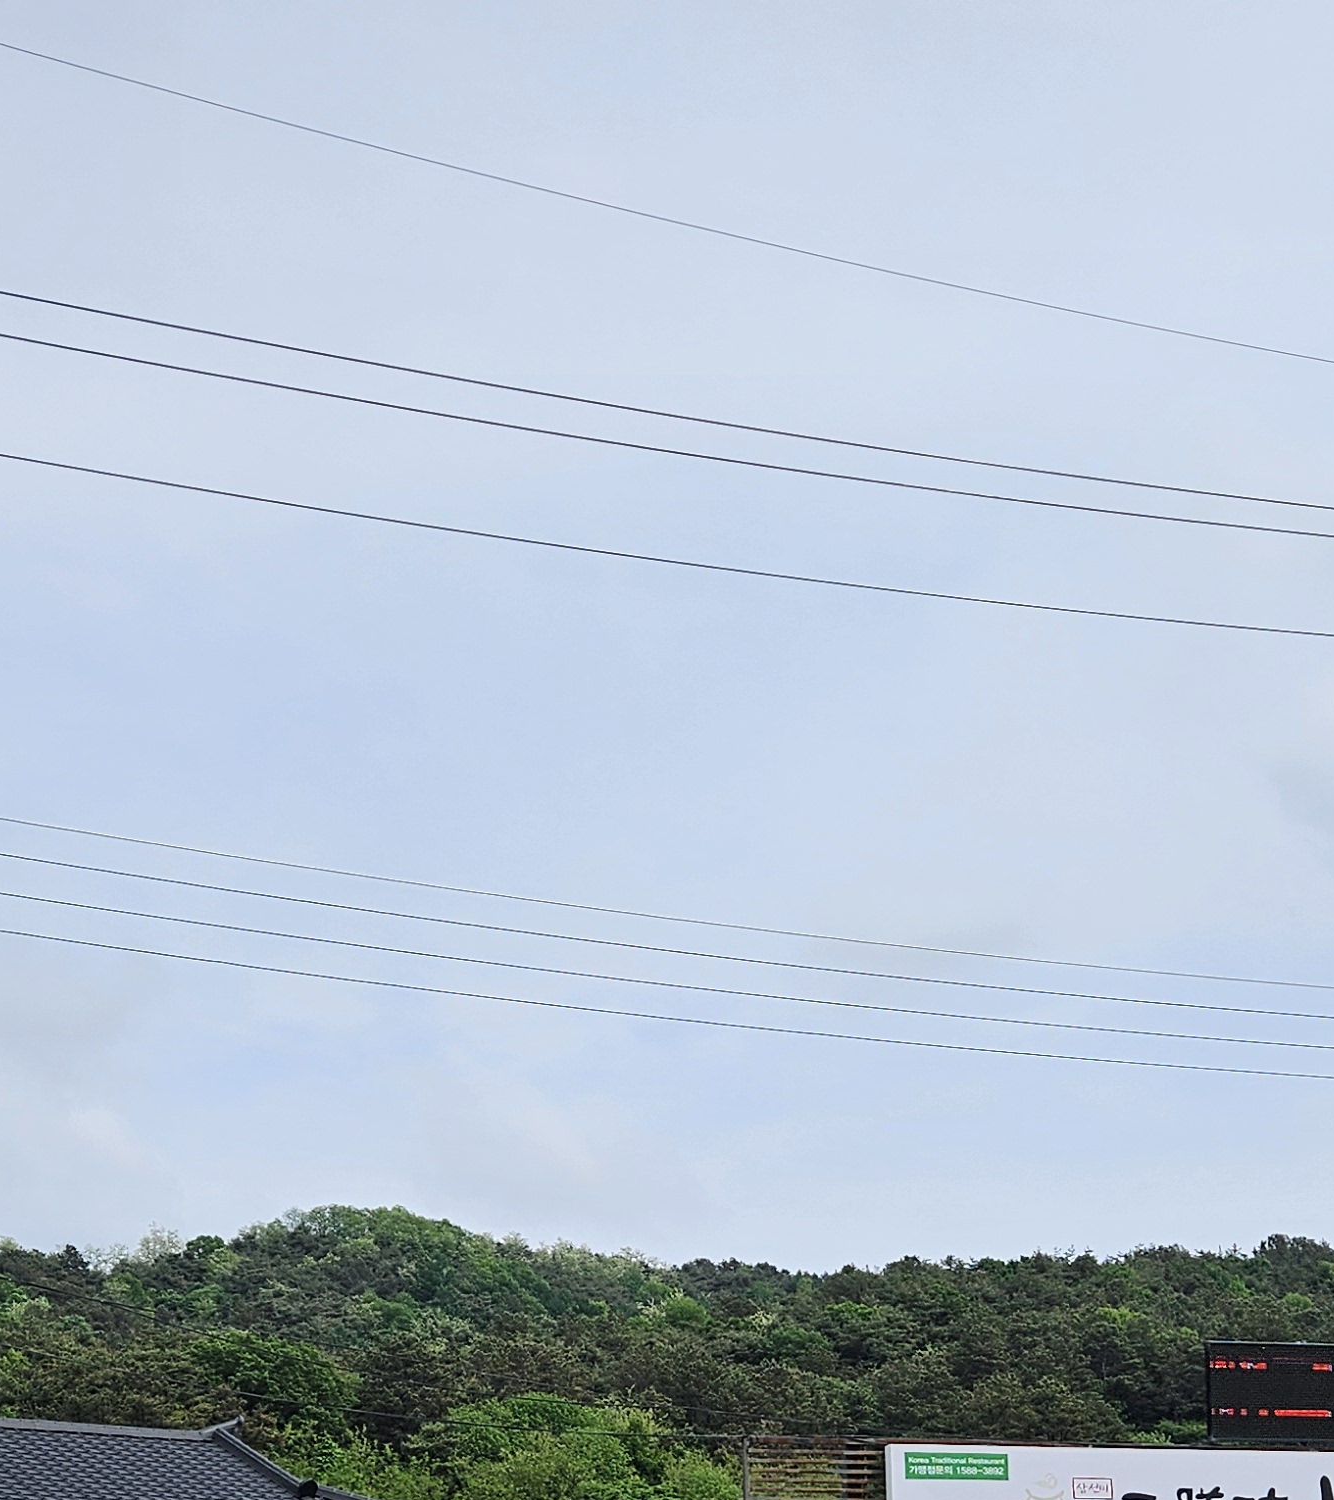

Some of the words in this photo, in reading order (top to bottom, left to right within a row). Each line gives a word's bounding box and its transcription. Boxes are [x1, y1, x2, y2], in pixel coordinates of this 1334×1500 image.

[908, 1456, 930, 1464] Korea
[931, 1456, 967, 1464] Traditional
[968, 1457, 1005, 1465] Restaurant
[909, 1465, 953, 1475] 가맹점문의
[956, 1466, 1005, 1476] 1588-3892
[1075, 1482, 1110, 1495] 삼선미
